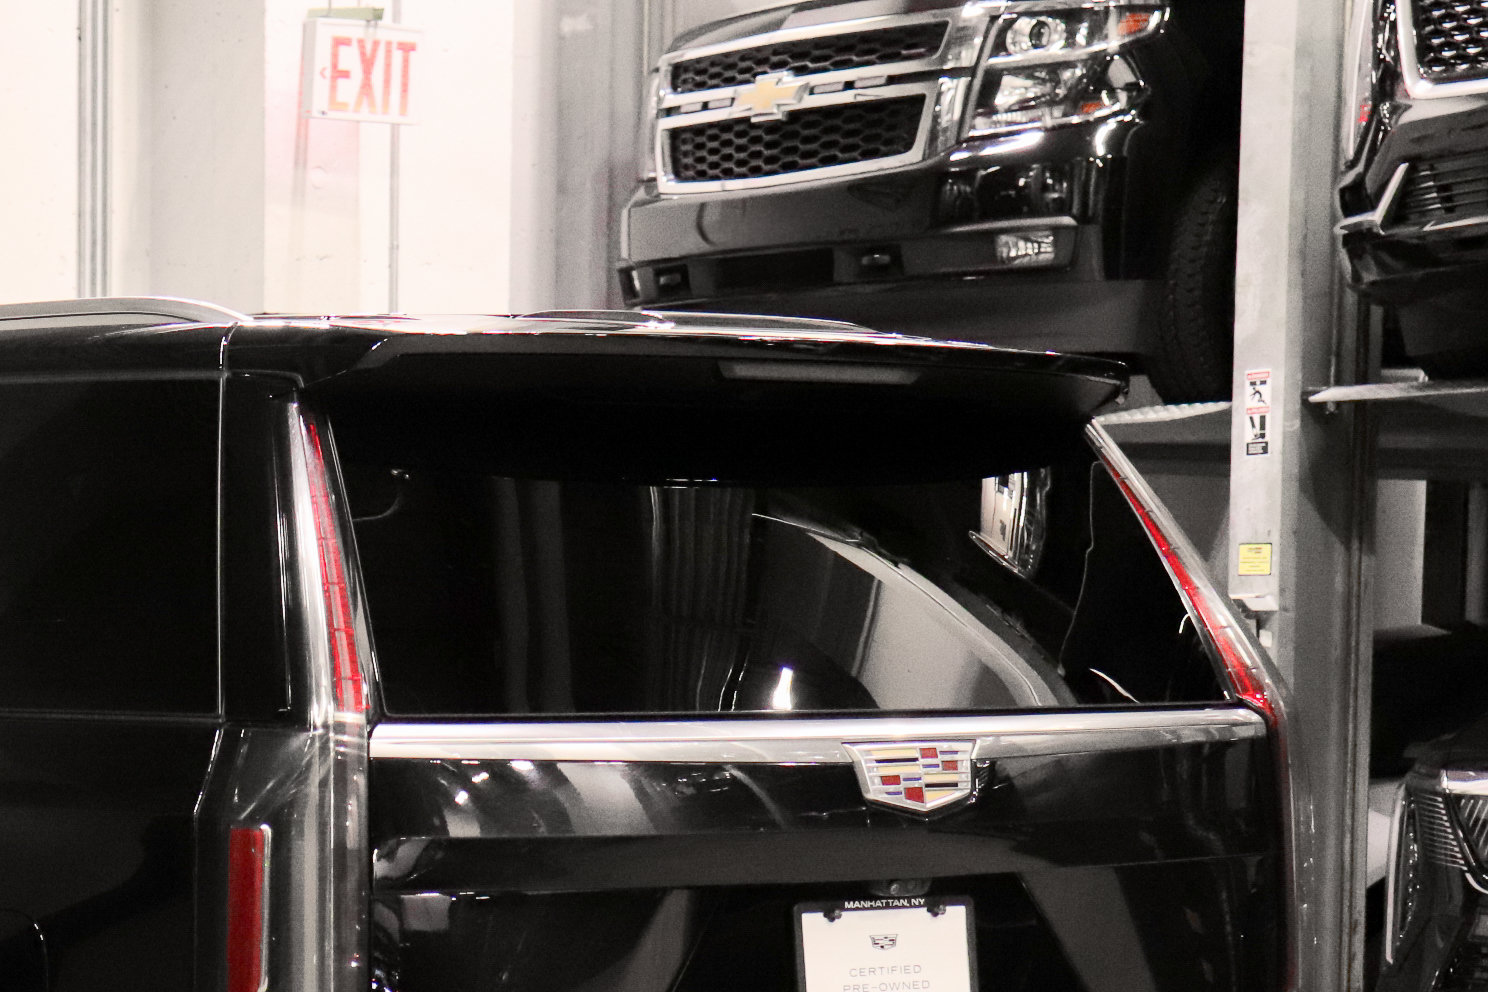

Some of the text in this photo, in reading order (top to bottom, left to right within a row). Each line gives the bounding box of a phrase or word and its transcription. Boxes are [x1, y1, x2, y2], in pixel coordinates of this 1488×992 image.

[328, 35, 417, 117] EXIT
[844, 897, 926, 909] MANHATTAN, NY
[848, 964, 923, 978] CERTIFIED
